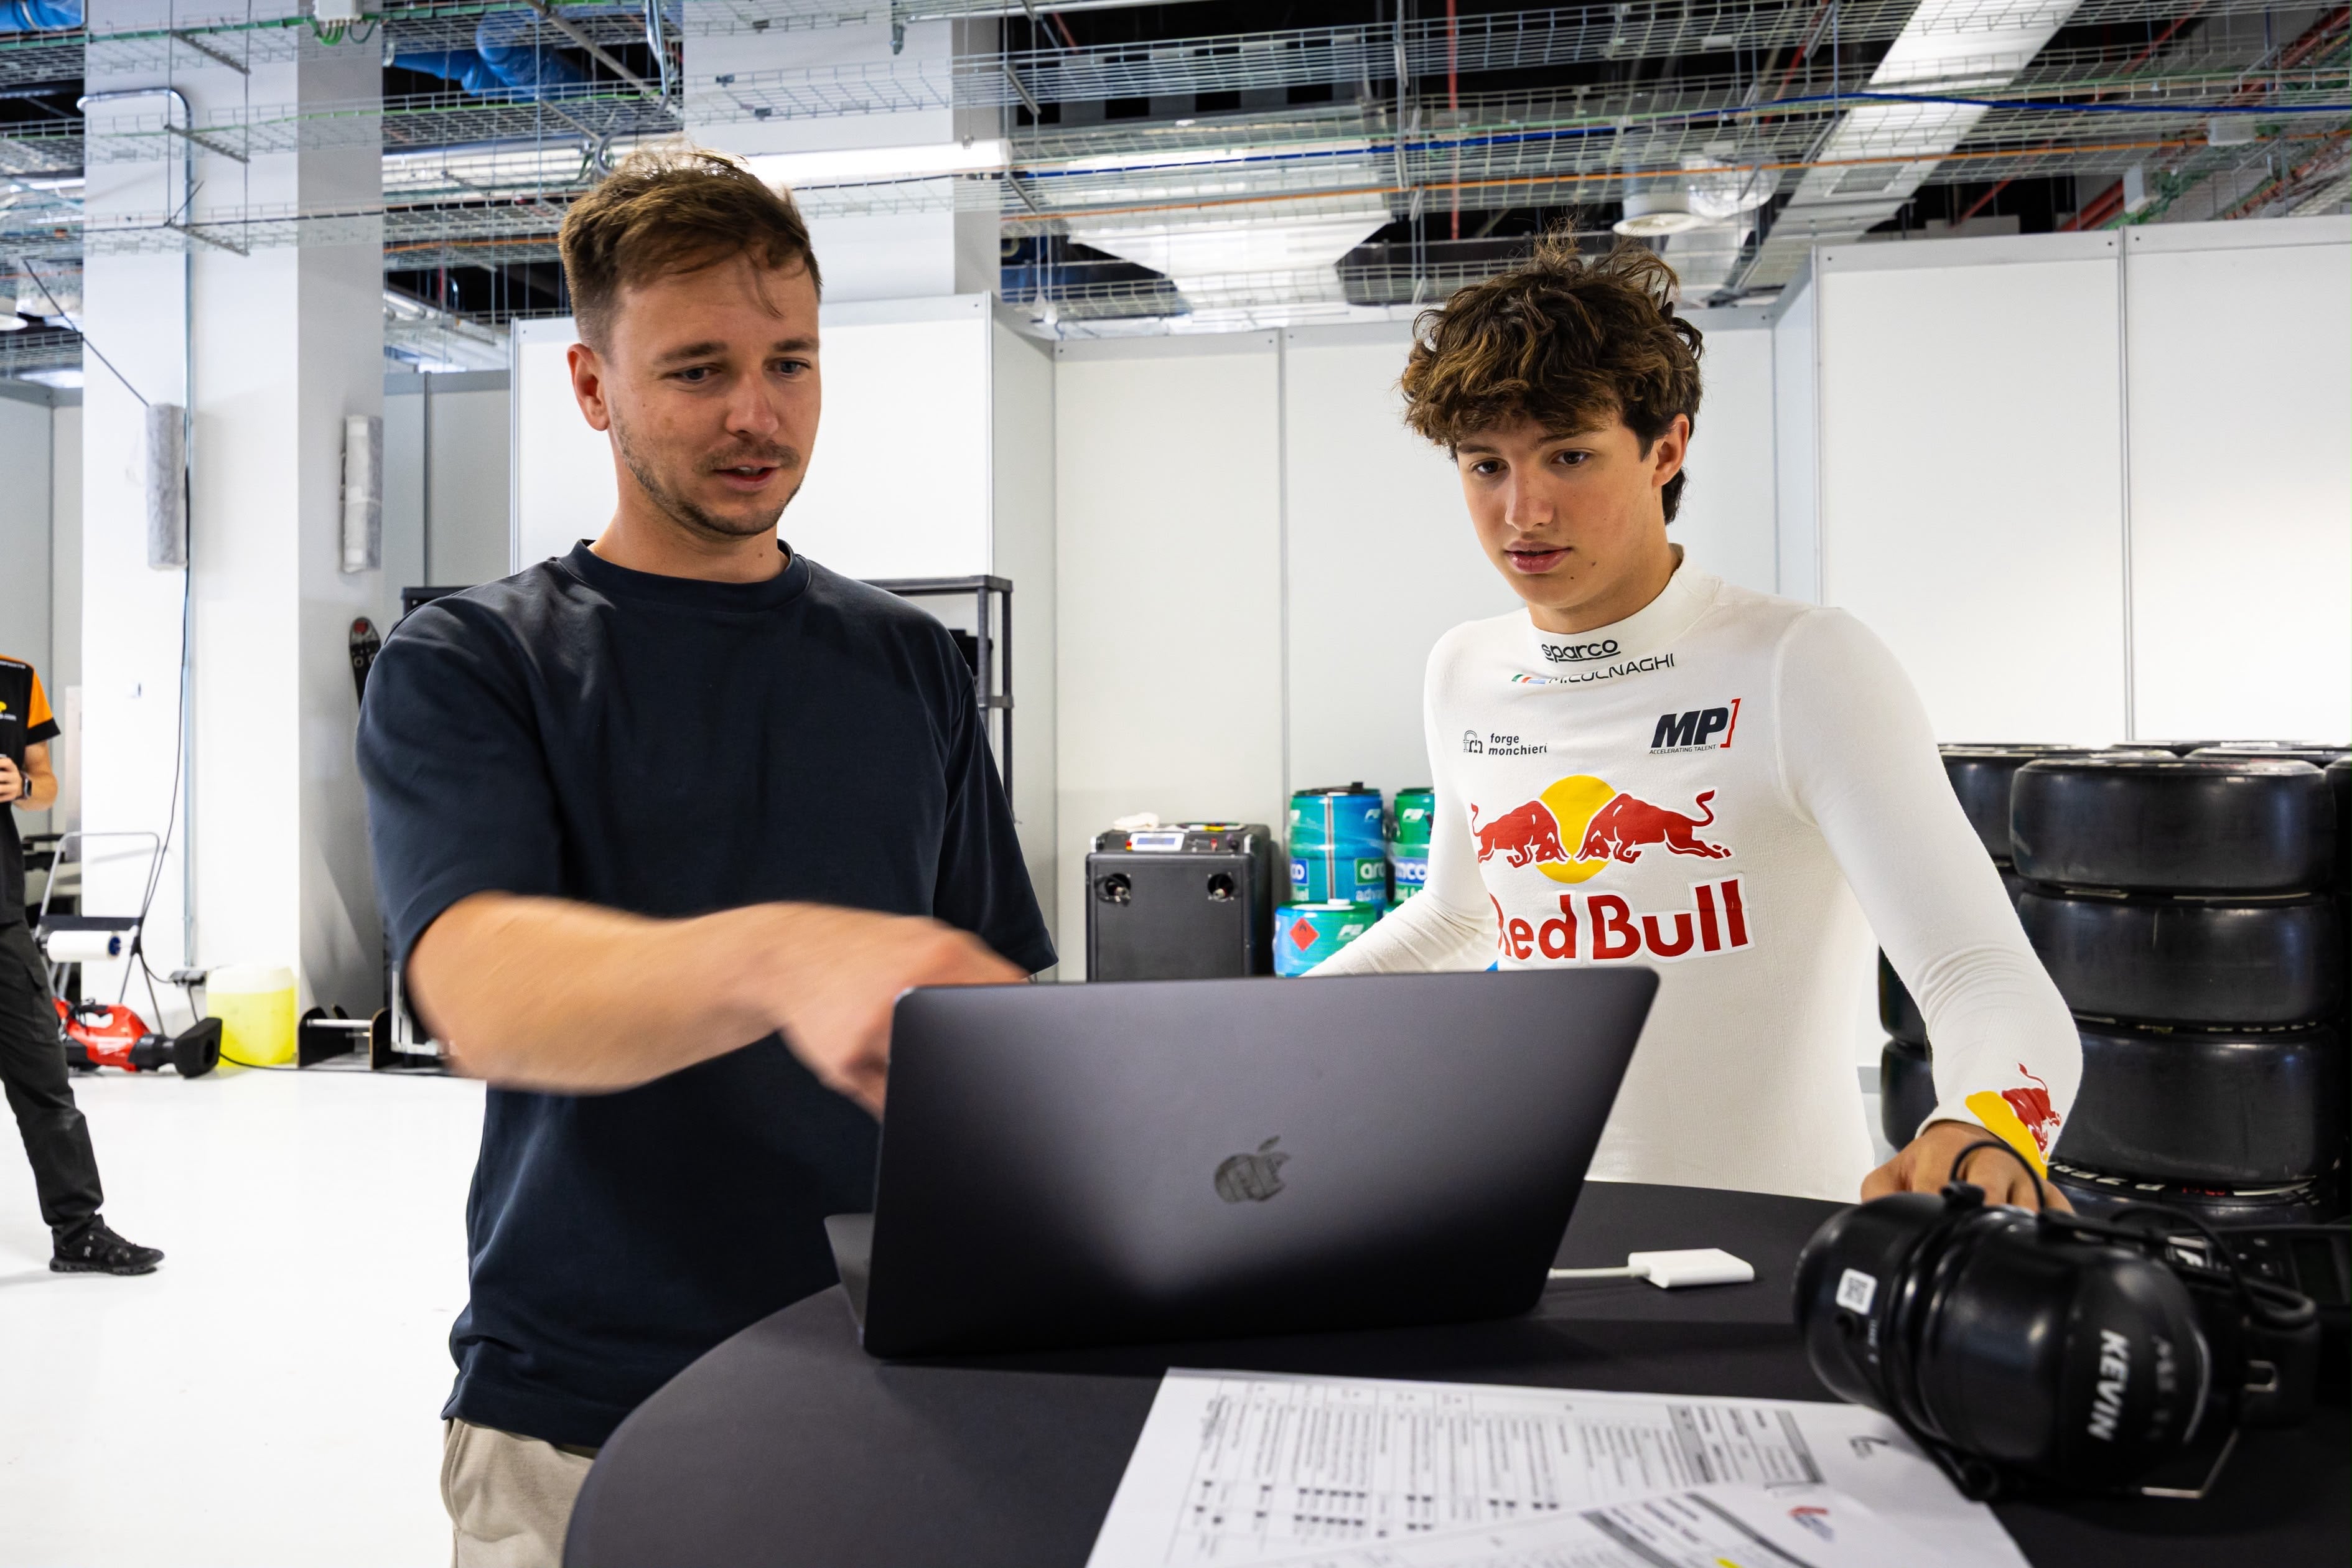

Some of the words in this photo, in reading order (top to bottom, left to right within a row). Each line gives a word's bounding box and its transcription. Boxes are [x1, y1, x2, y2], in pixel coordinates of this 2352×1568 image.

[1541, 639, 1621, 663] sparco
[1490, 733, 1519, 745] forge
[1694, 744, 1717, 752] TALENT
[1488, 743, 1547, 755] monchieri
[1587, 879, 1748, 960] Bull
[2088, 1329, 2130, 1442] KEVIN
